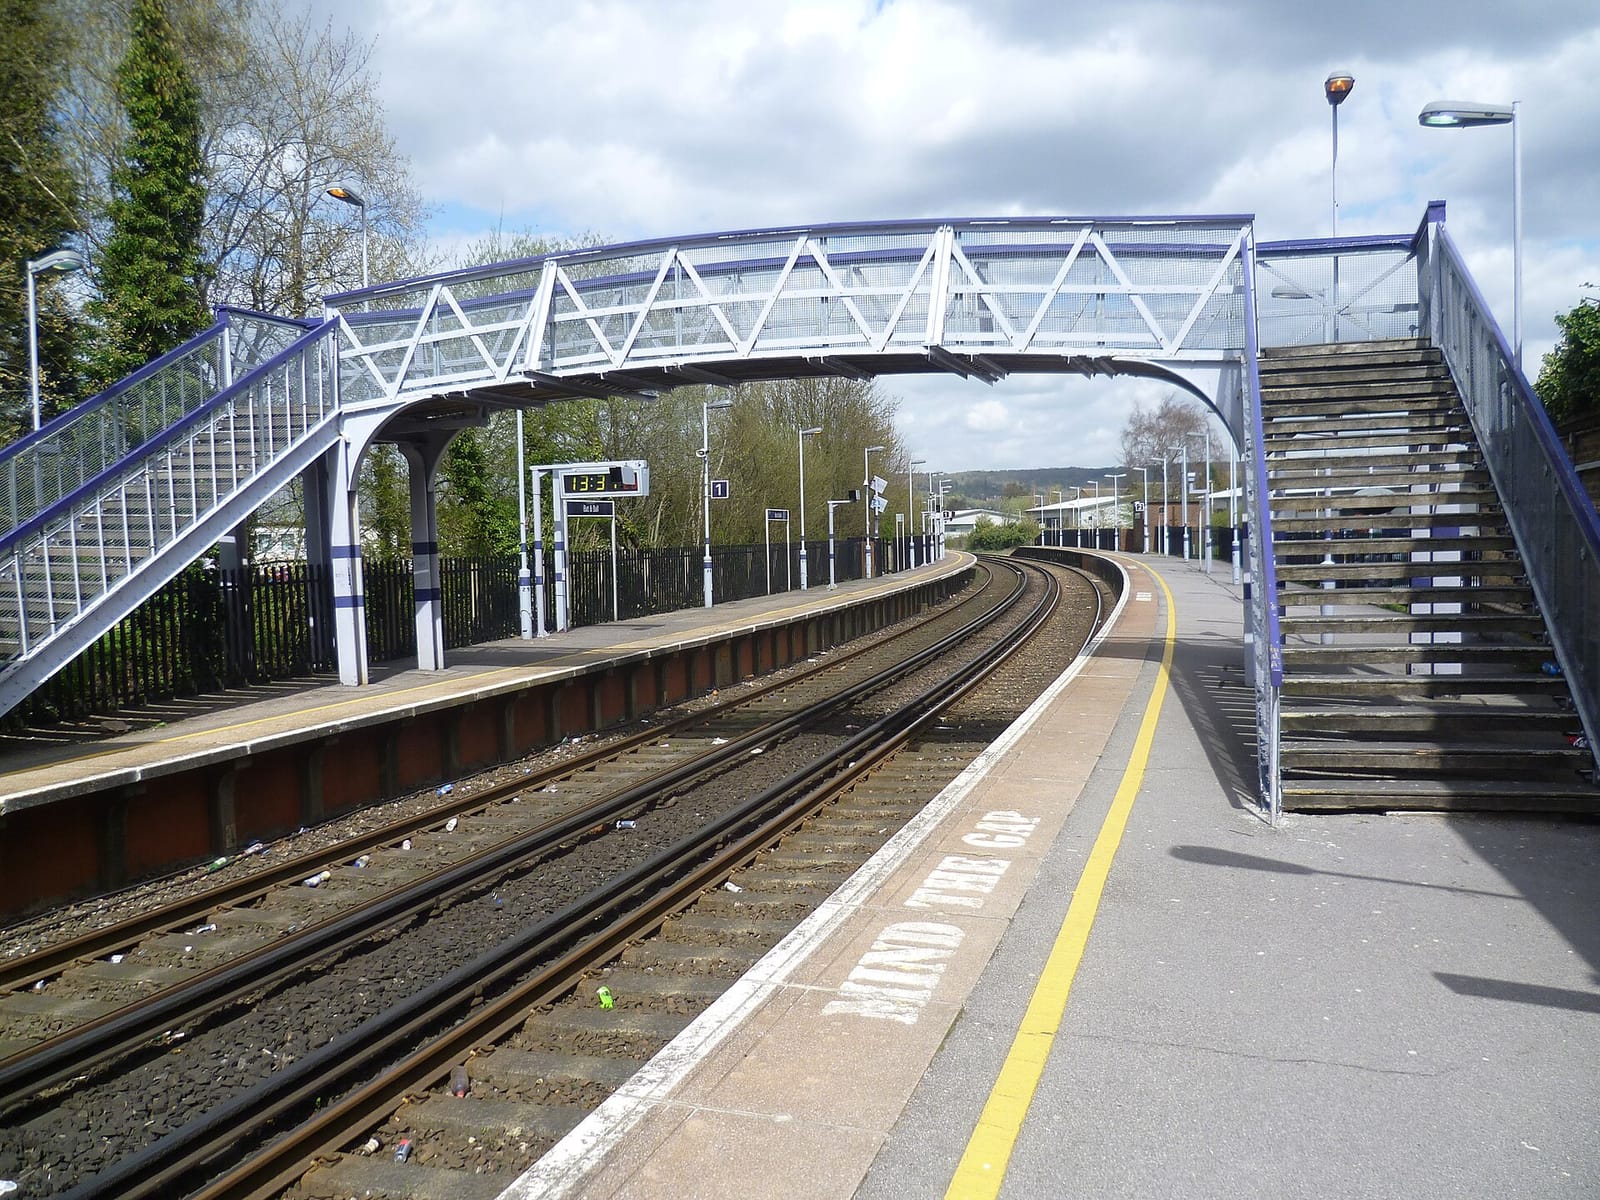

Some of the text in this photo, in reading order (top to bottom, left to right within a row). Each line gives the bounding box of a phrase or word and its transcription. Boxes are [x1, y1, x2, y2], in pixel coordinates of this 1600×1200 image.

[715, 483, 722, 496] 1
[820, 810, 1041, 1025] MIND THE GAP
